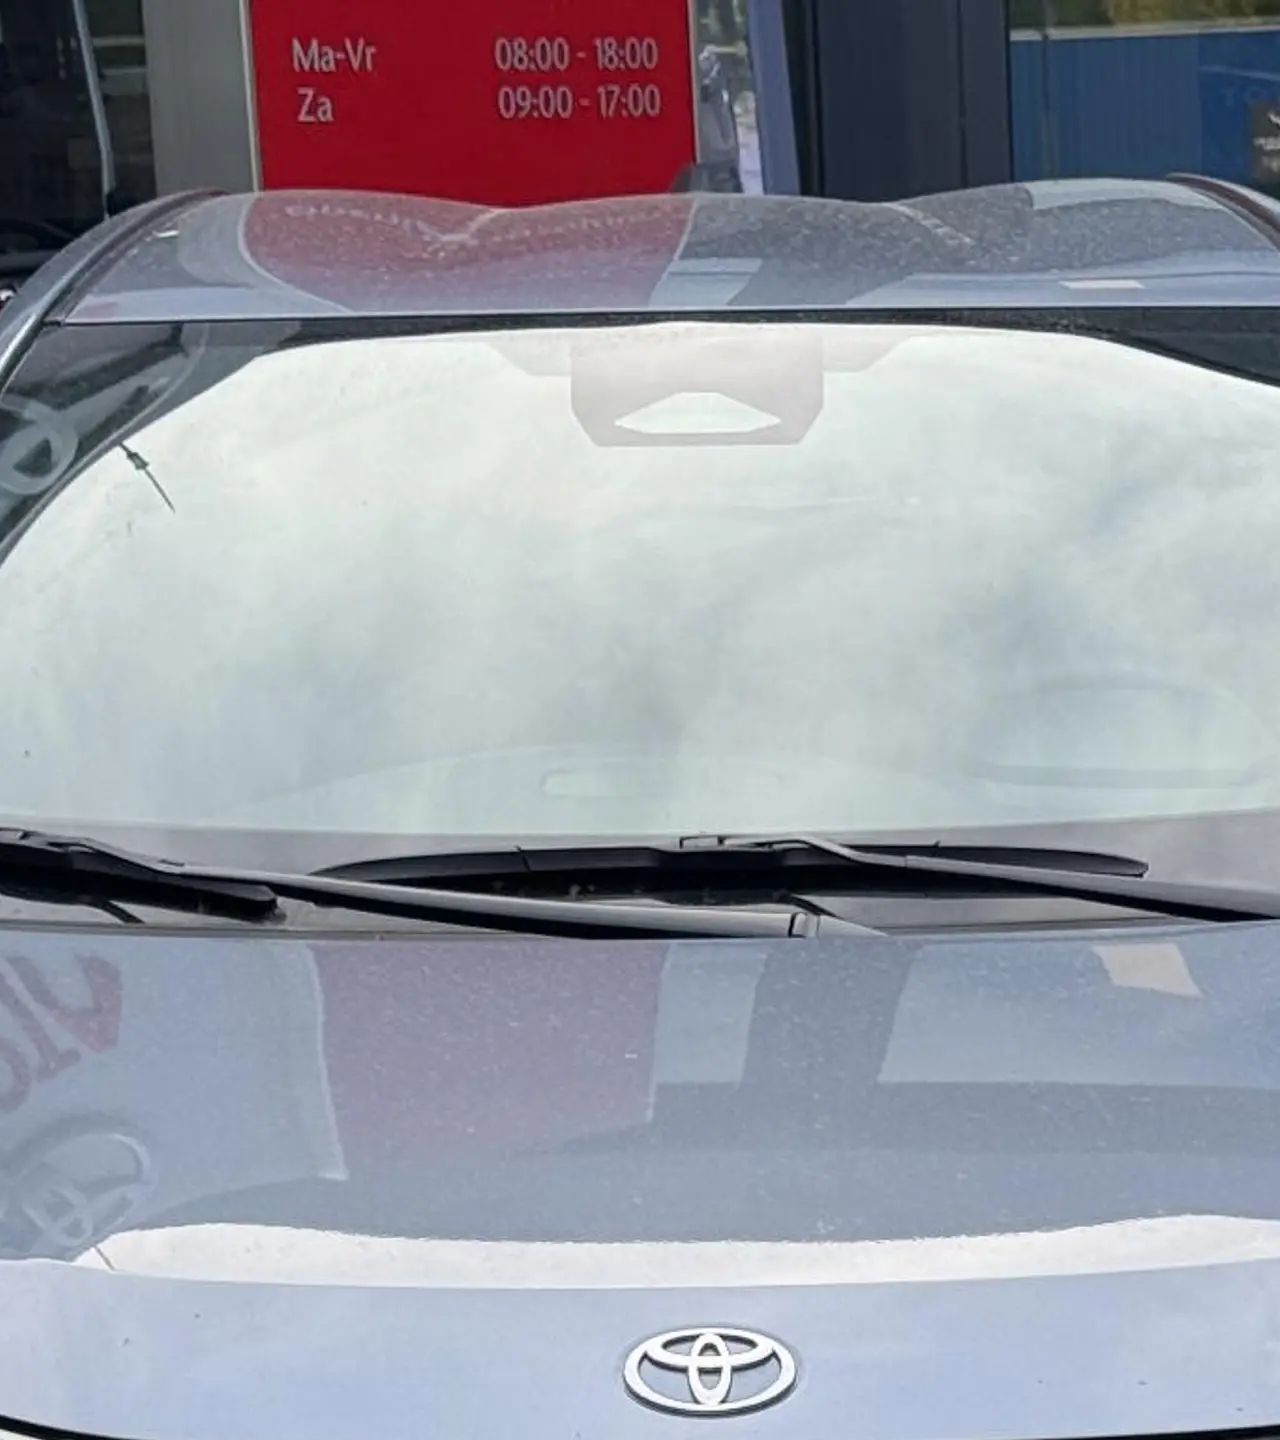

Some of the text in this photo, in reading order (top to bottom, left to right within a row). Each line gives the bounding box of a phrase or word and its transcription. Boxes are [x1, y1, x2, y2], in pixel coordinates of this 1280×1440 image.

[291, 37, 377, 73] Ma-Vr
[494, 36, 570, 71] 08:00
[595, 36, 658, 71] 18:00
[296, 87, 334, 122] Za
[498, 85, 573, 119] 09:00
[597, 84, 661, 117] 17:00
